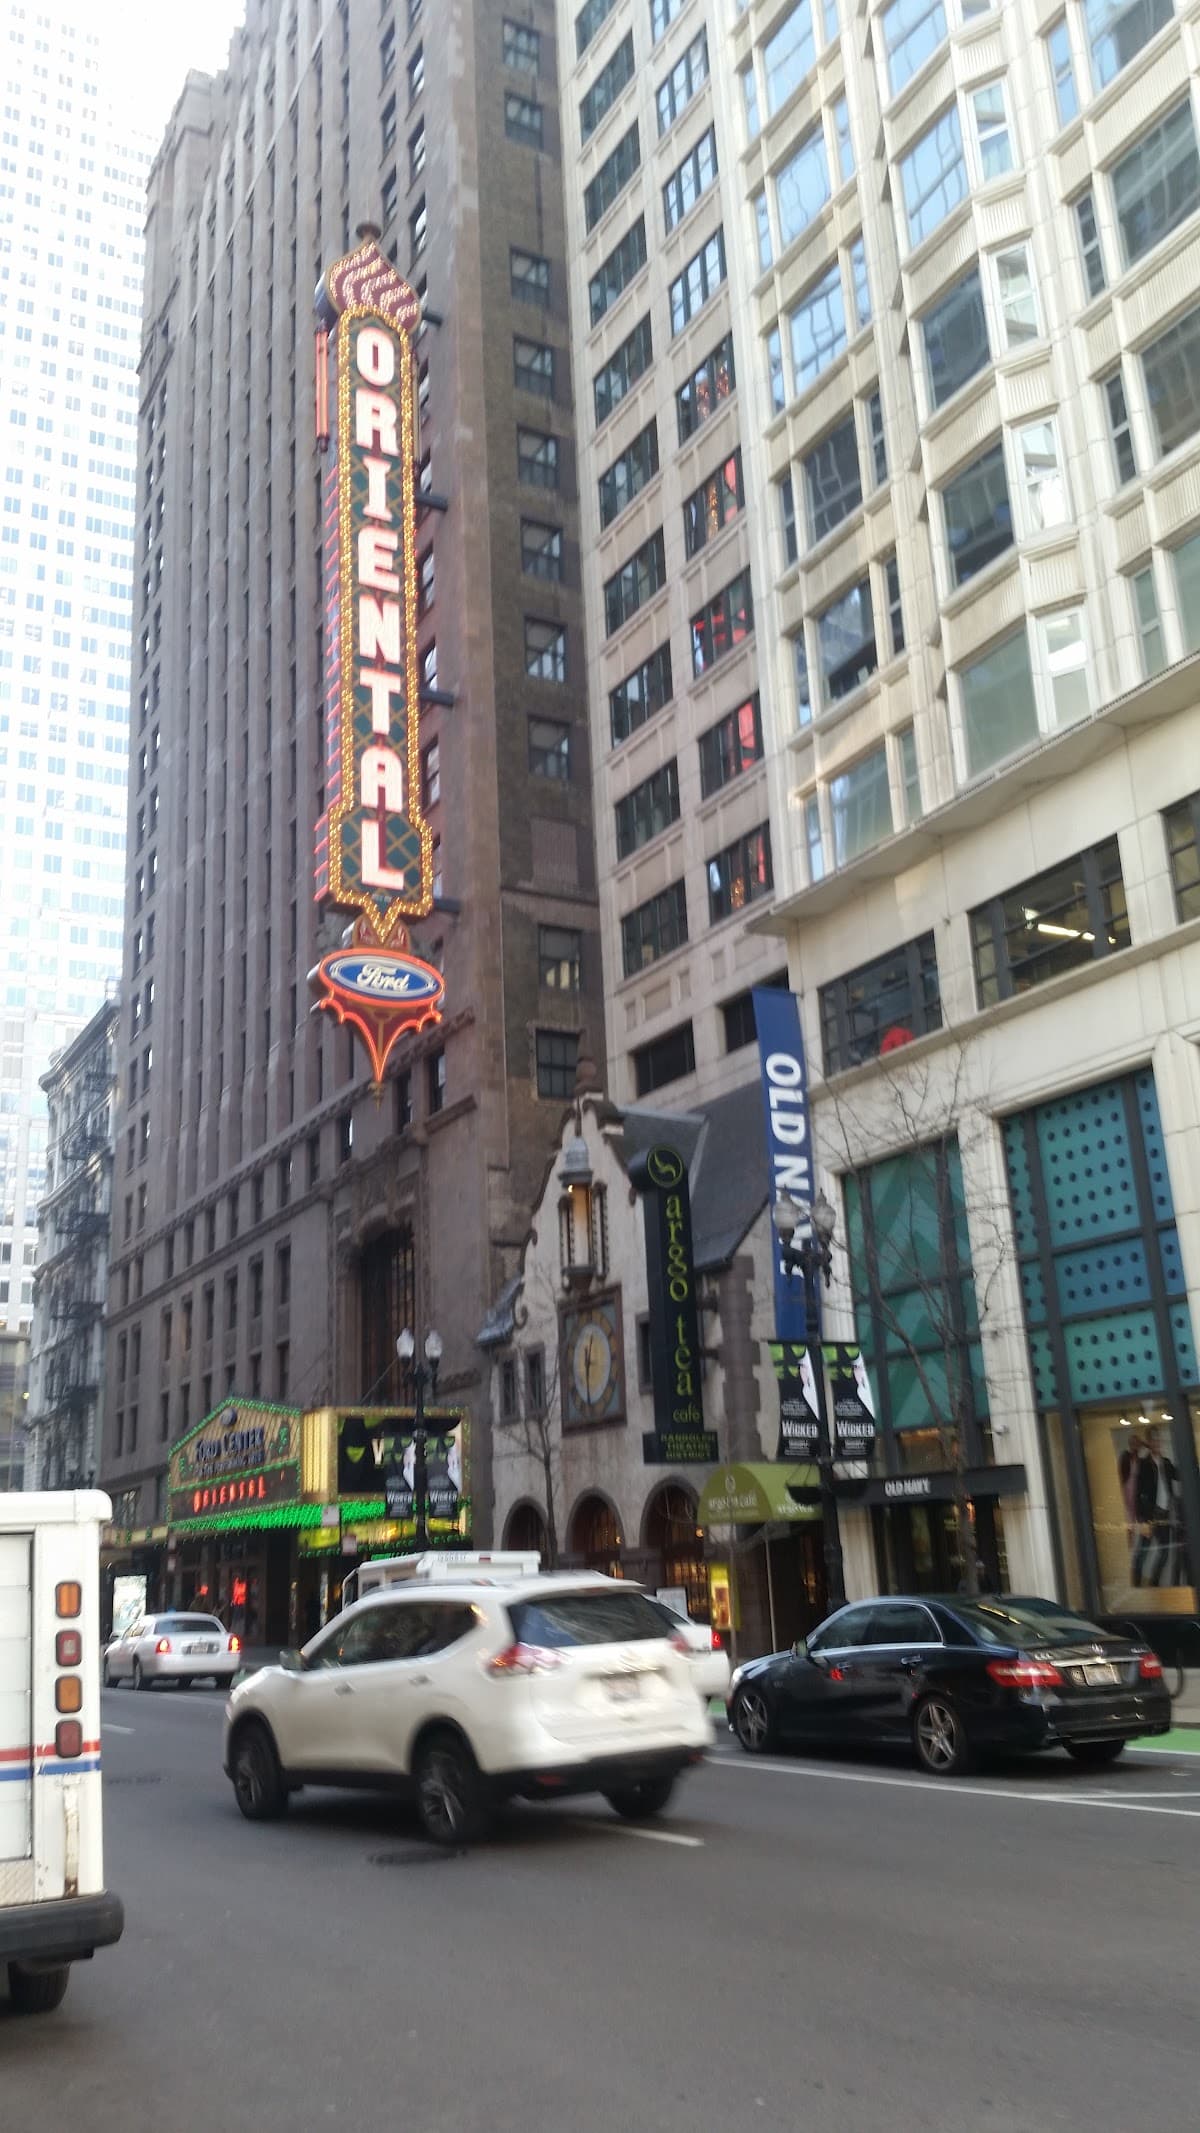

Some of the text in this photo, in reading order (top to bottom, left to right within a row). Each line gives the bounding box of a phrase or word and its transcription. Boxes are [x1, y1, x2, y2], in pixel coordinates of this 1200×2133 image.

[356, 327, 404, 889] ORIENTAL
[357, 963, 411, 992] Ford
[765, 1052, 807, 1145] OLD
[665, 1194, 693, 1396] argo tea
[782, 1420, 819, 1438] WICKED
[836, 1420, 876, 1438] WICKED
[884, 1478, 930, 1496] OLD NAVY
